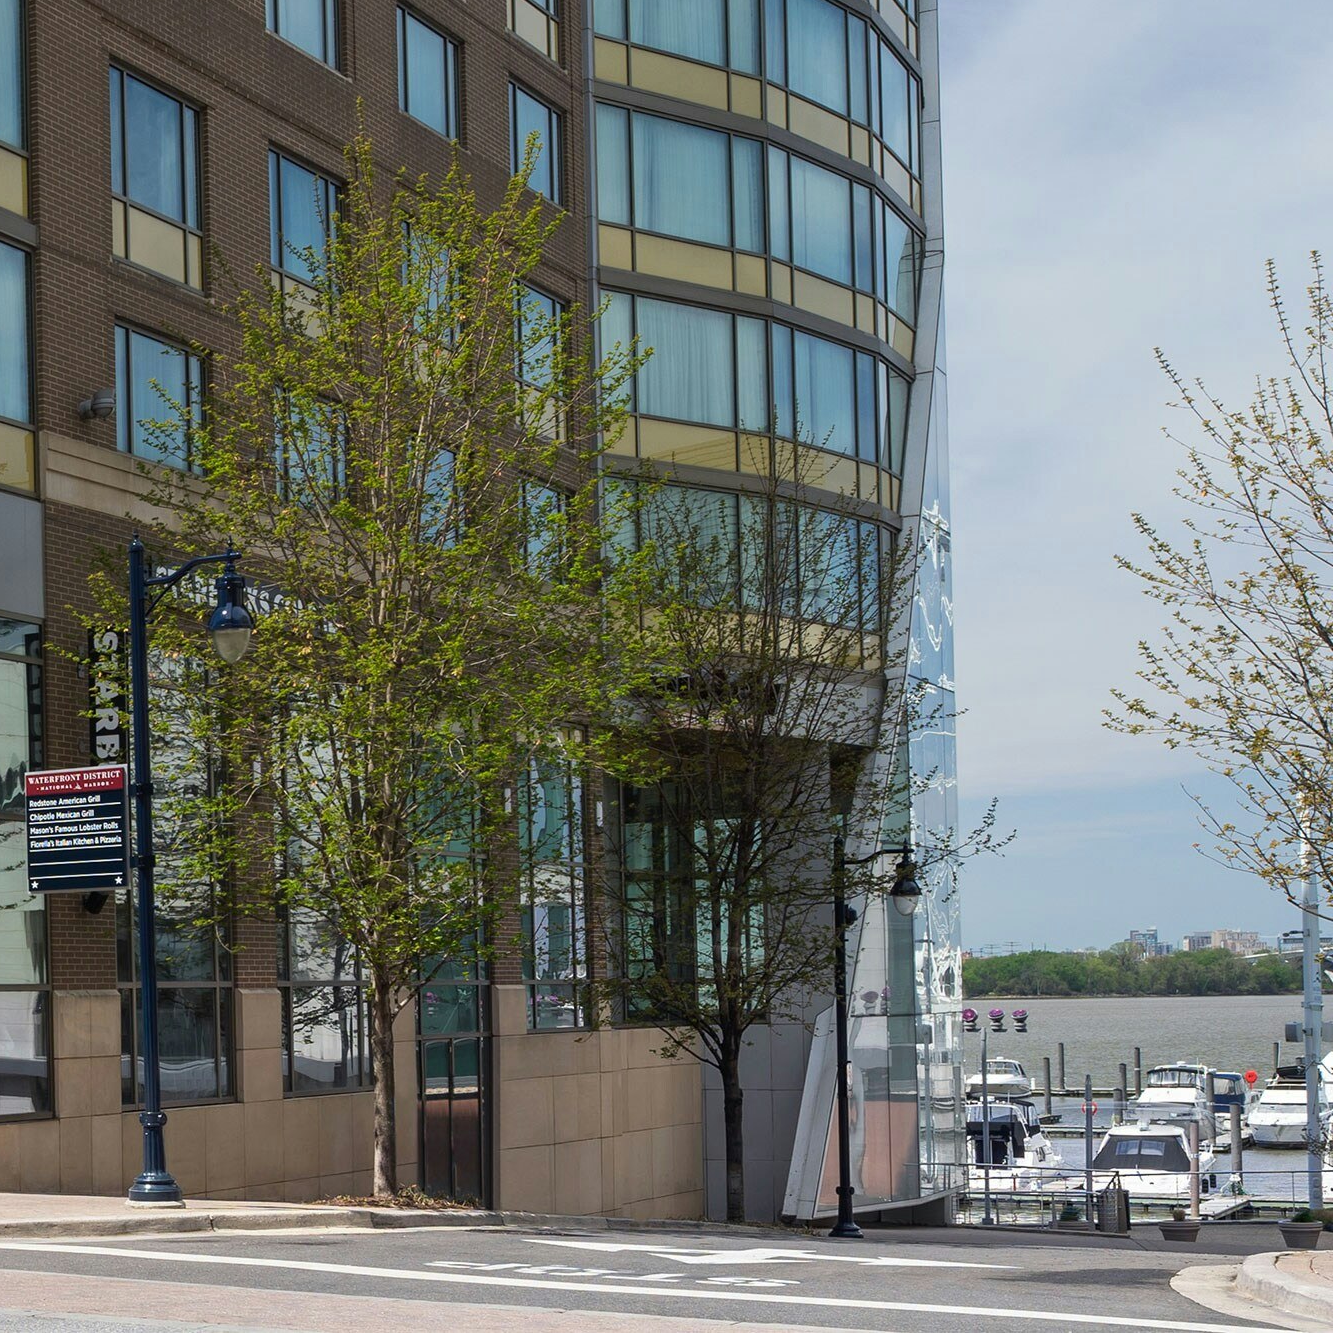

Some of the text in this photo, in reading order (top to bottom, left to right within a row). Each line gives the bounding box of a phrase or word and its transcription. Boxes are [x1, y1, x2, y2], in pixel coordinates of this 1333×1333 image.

[28, 770, 121, 785] WATERFRONT DISTRICT
[29, 799, 57, 808] Redstone
[58, 797, 87, 805] American
[29, 809, 95, 822] Chipotle Mexican Grill
[29, 827, 54, 835] Mason's
[54, 825, 78, 833] Famous
[79, 823, 103, 832] Lobster
[55, 839, 73, 847] Italian
[73, 837, 94, 845] Kitchen
[99, 835, 122, 844] Pizzeria
